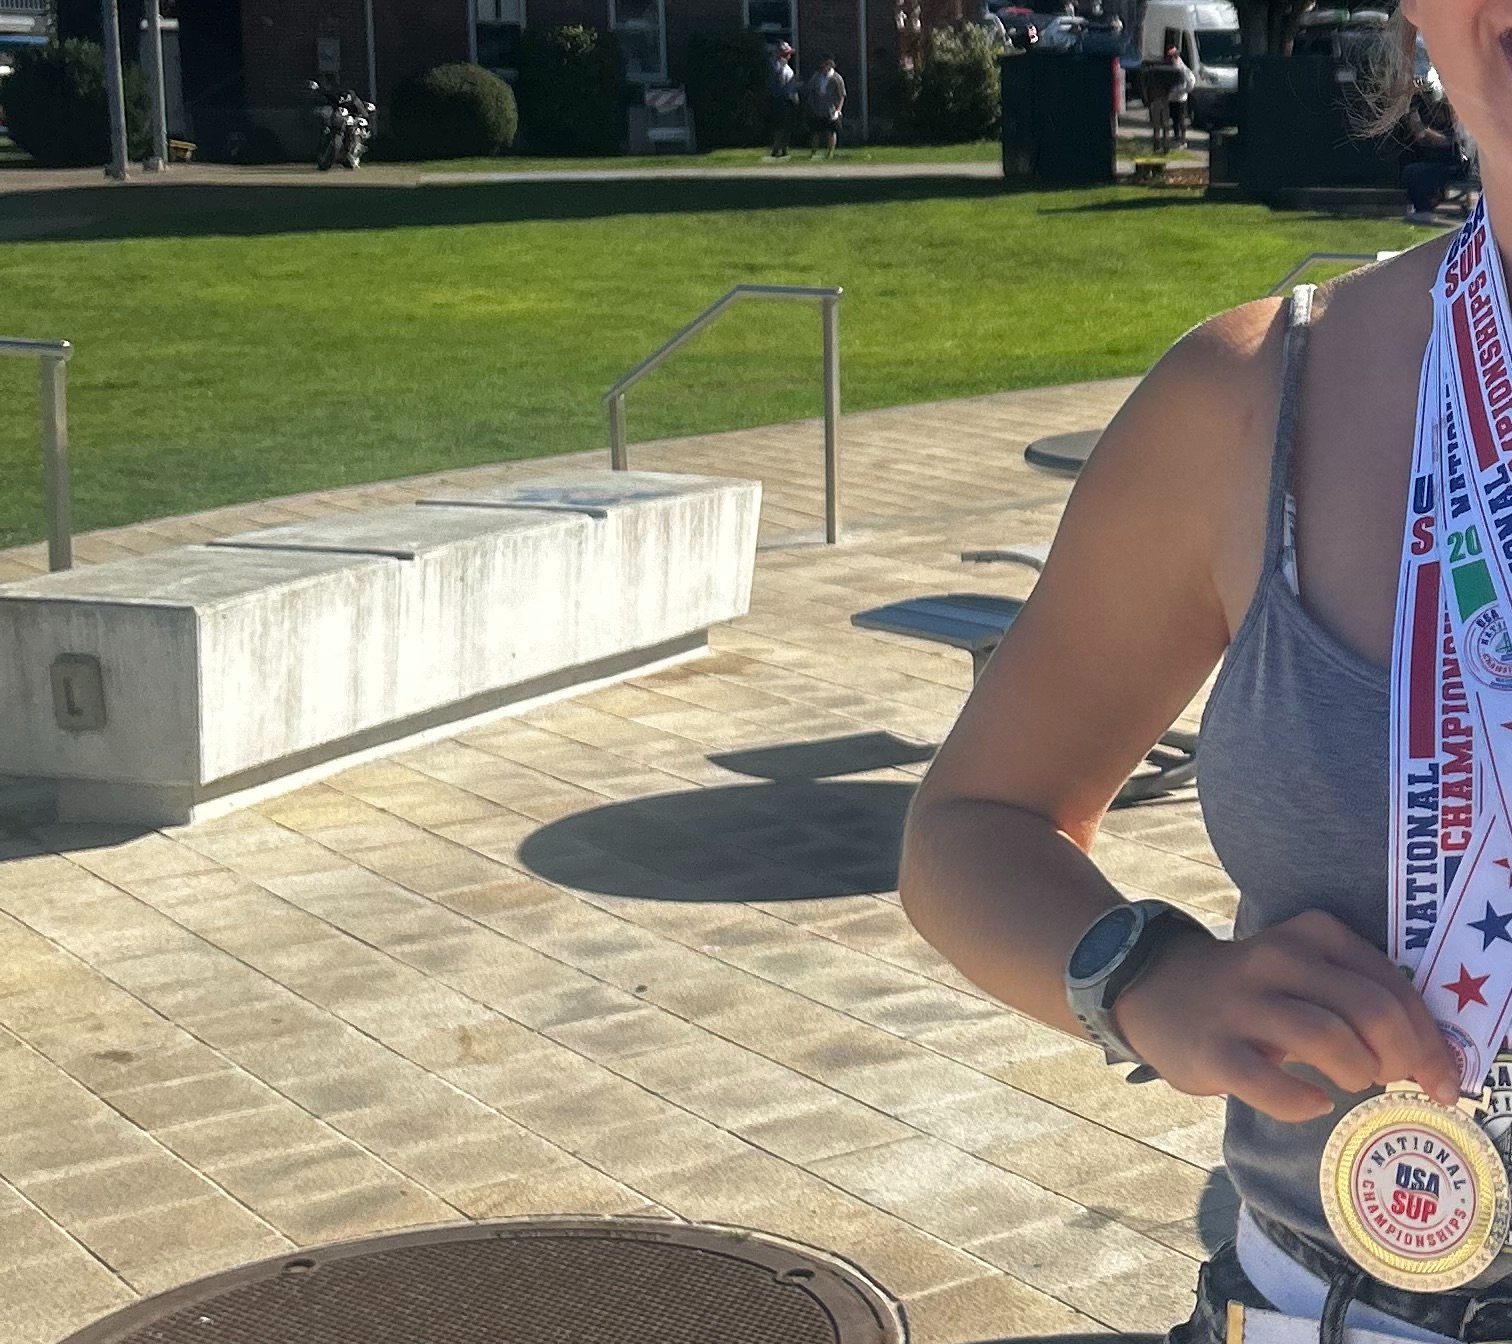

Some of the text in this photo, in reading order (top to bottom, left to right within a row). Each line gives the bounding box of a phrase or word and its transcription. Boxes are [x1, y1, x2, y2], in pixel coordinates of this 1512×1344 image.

[1445, 224, 1486, 298] SUP
[1447, 524, 1483, 563] 20
[1405, 762, 1440, 950] NATIONAL
[1371, 1136, 1467, 1191] NATIONAL
[1395, 1162, 1440, 1198] USA
[1362, 1179, 1467, 1248] CHAMPIONSHIPS
[1391, 1189, 1438, 1224] SUP
